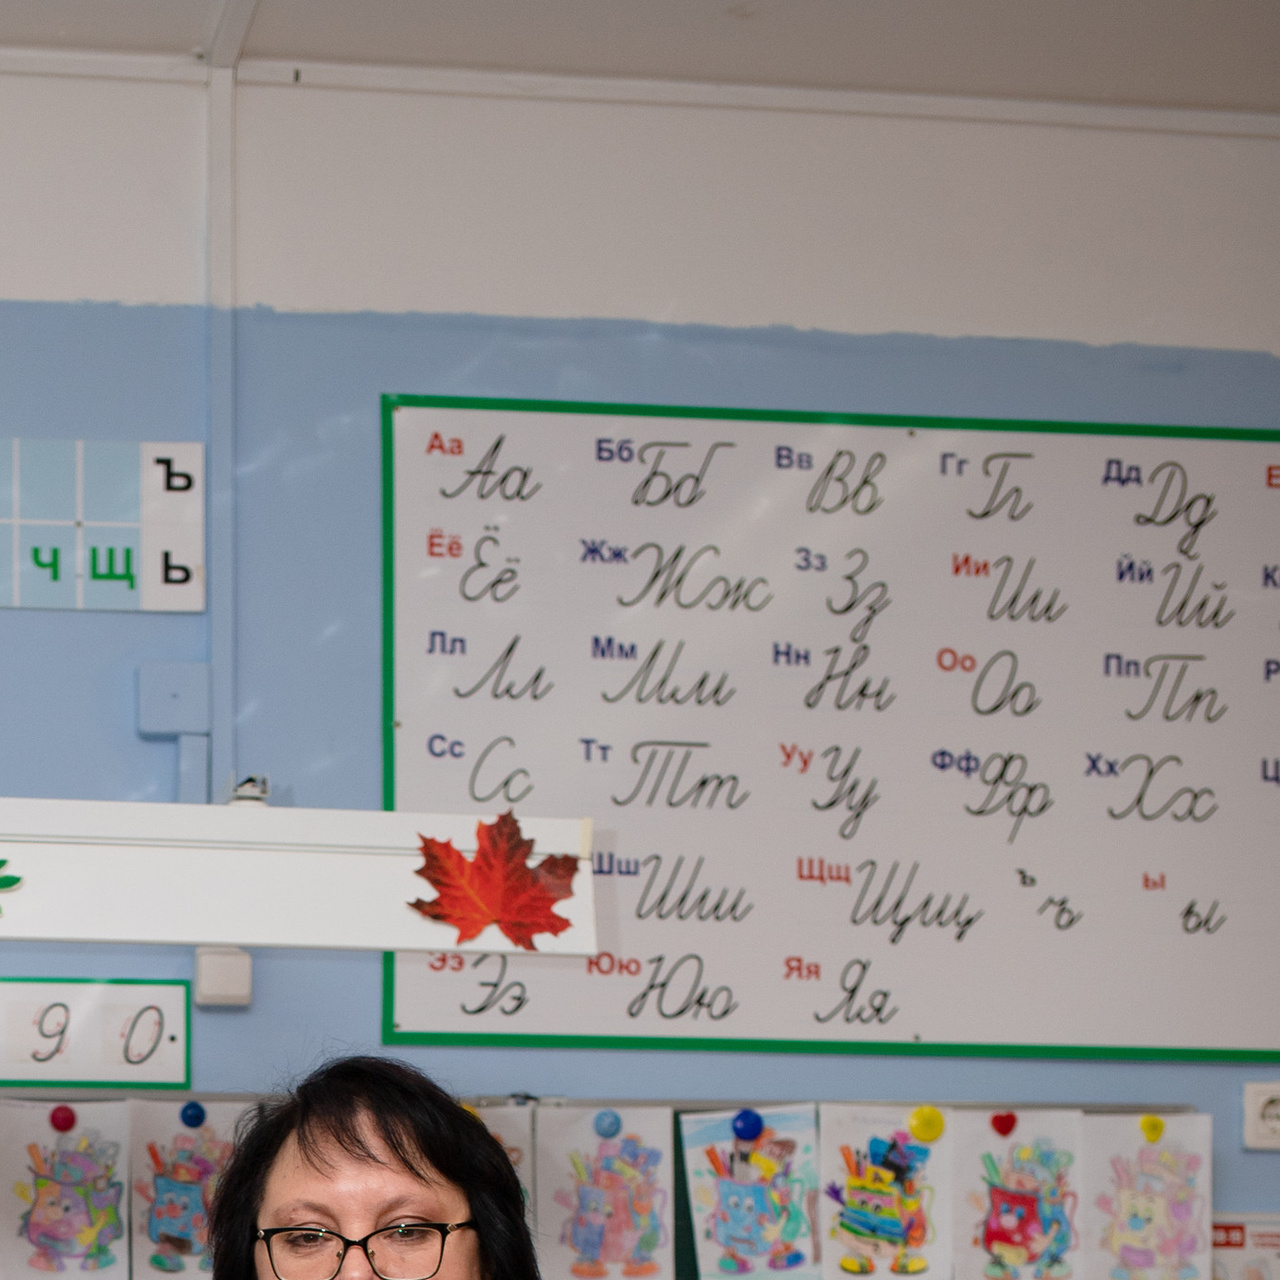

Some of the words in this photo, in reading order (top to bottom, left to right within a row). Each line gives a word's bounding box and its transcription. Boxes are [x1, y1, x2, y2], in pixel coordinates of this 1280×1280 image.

[154, 457, 194, 492] ъ
[426, 432, 464, 456] Аа
[595, 438, 634, 462] Бб
[775, 446, 814, 470] Вв
[940, 452, 969, 476] Гг
[1102, 459, 1143, 486] Дд
[33, 547, 60, 582] ч
[91, 547, 137, 591] щ
[161, 551, 192, 585] ь
[426, 529, 463, 557] Ёё
[580, 539, 629, 564] Жж
[795, 548, 828, 571] Зз
[952, 554, 989, 578] Ии
[1117, 554, 1154, 582] Йй
[427, 630, 466, 656] Лл
[592, 636, 637, 660] Мм
[773, 644, 810, 666] Нн
[936, 647, 976, 672] Оо
[1104, 654, 1140, 679] Пп
[427, 734, 464, 758] Сс
[580, 738, 611, 762] Тт
[779, 743, 814, 773] Уу
[931, 749, 980, 778] Фф
[1085, 752, 1119, 776] Хх
[797, 858, 852, 885] Щщ
[587, 951, 641, 976] Юю
[784, 957, 821, 980] Яя
[32, 1003, 70, 1062] 9
[122, 1005, 164, 1066] 0
